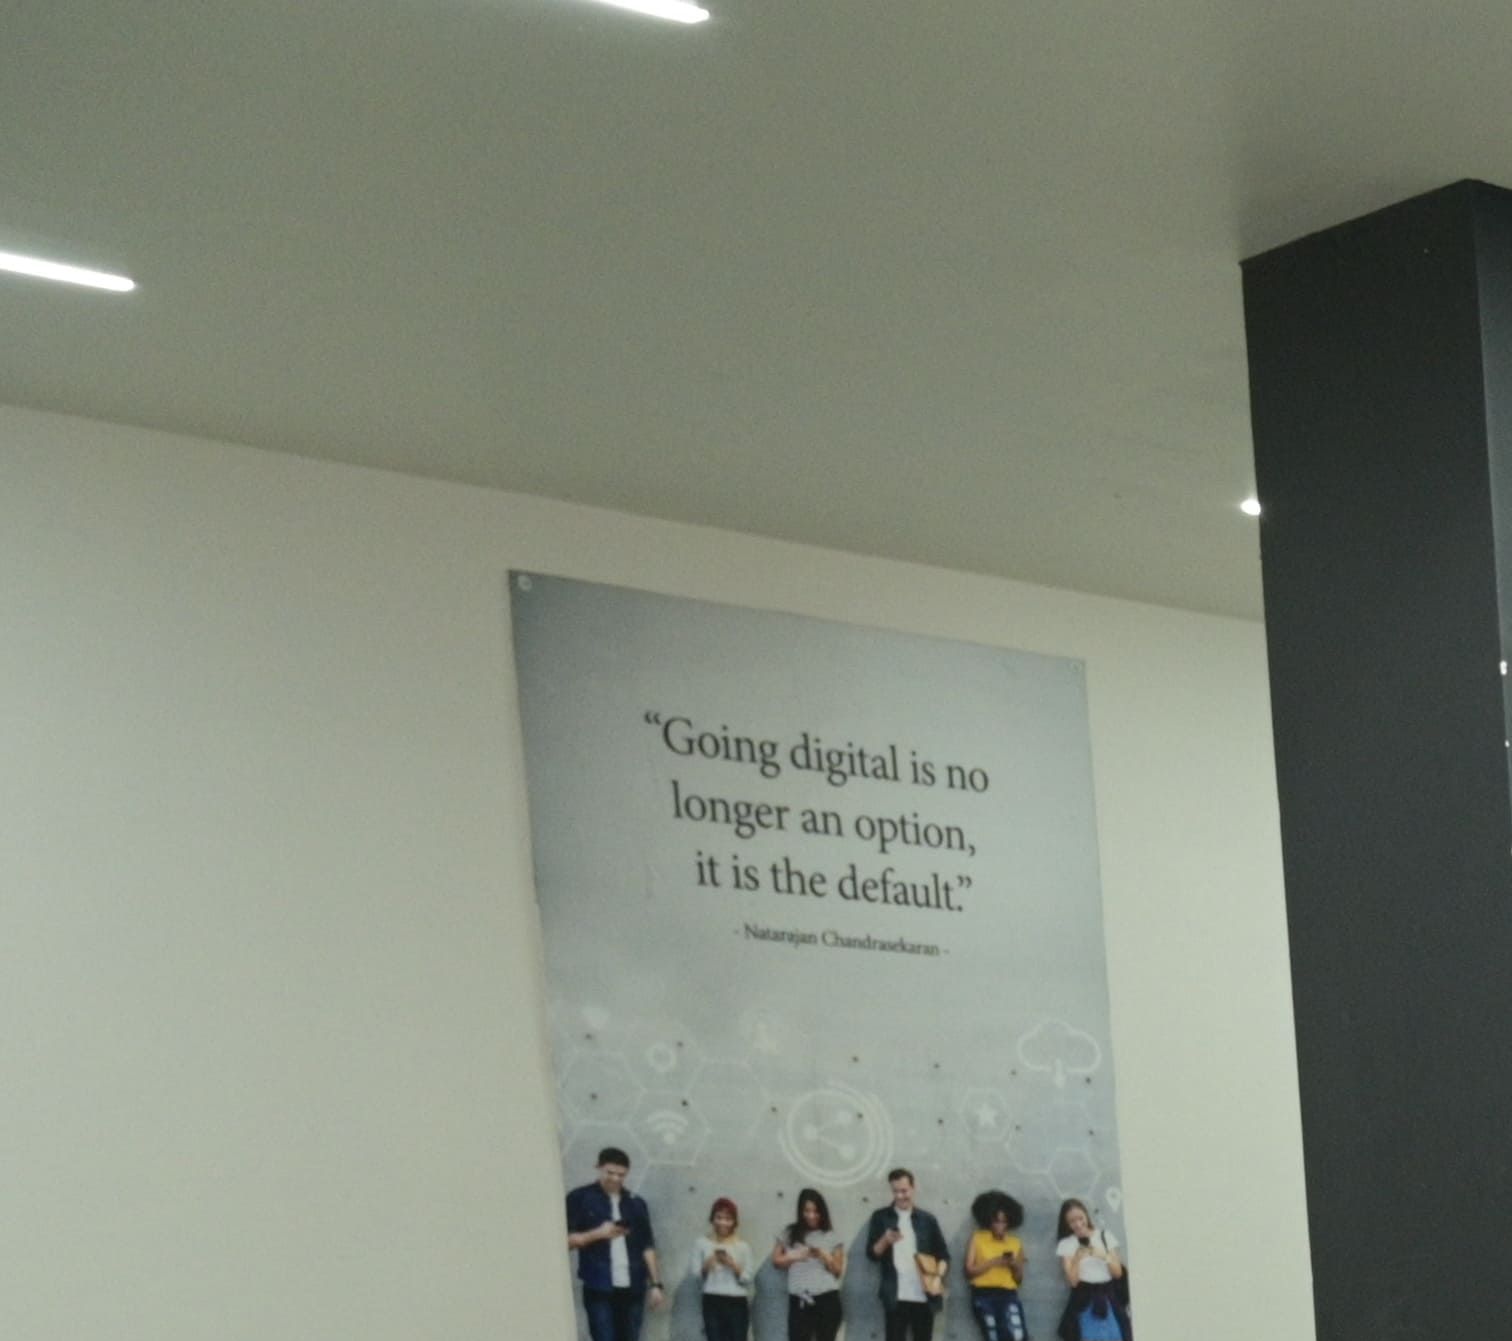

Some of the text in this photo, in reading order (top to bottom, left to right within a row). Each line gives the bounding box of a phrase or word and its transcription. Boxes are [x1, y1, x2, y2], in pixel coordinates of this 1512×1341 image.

[644, 711, 990, 793] “Going digital is no
[671, 779, 976, 857] longer an option,
[697, 851, 721, 888] it
[732, 855, 760, 892] is
[770, 857, 828, 898] the
